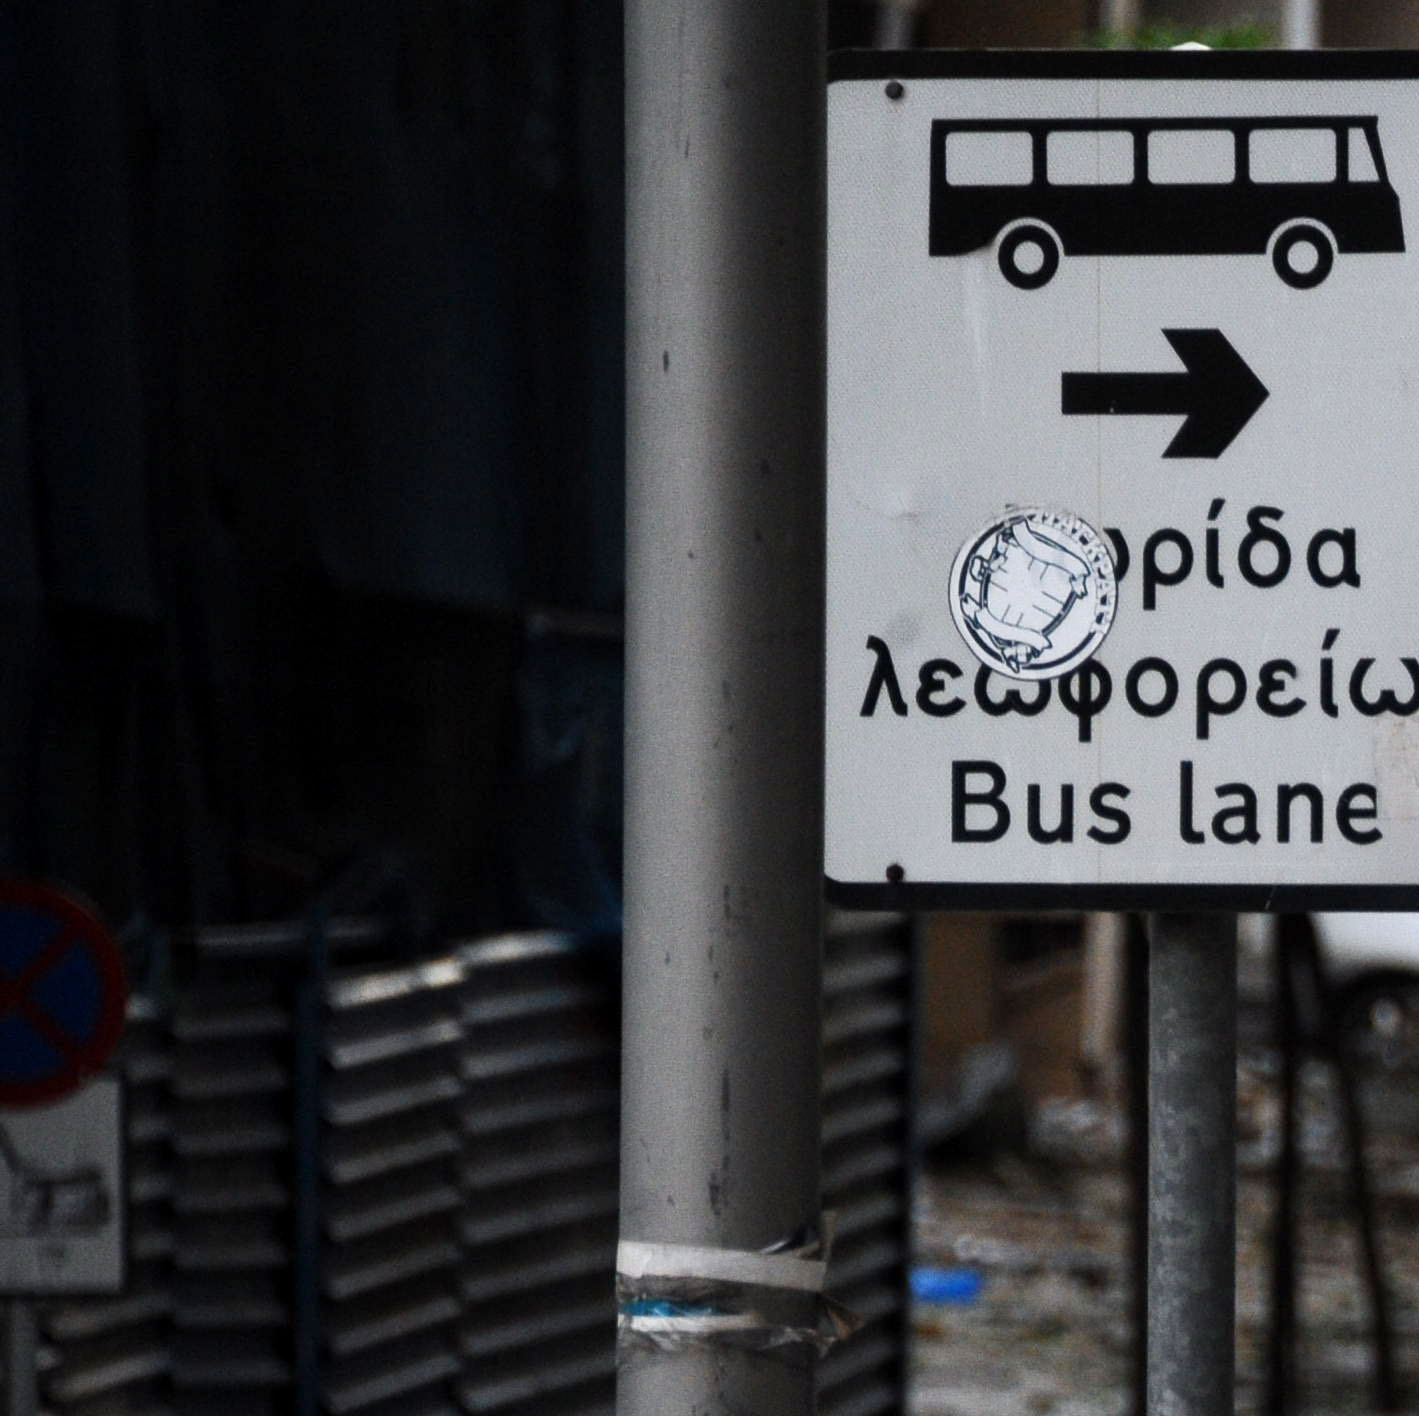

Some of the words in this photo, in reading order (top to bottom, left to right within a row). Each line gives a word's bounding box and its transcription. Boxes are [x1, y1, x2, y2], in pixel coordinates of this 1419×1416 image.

[1103, 497, 1361, 611] ρίδα
[951, 760, 1131, 845] Bus
[1180, 760, 1384, 845] lane
